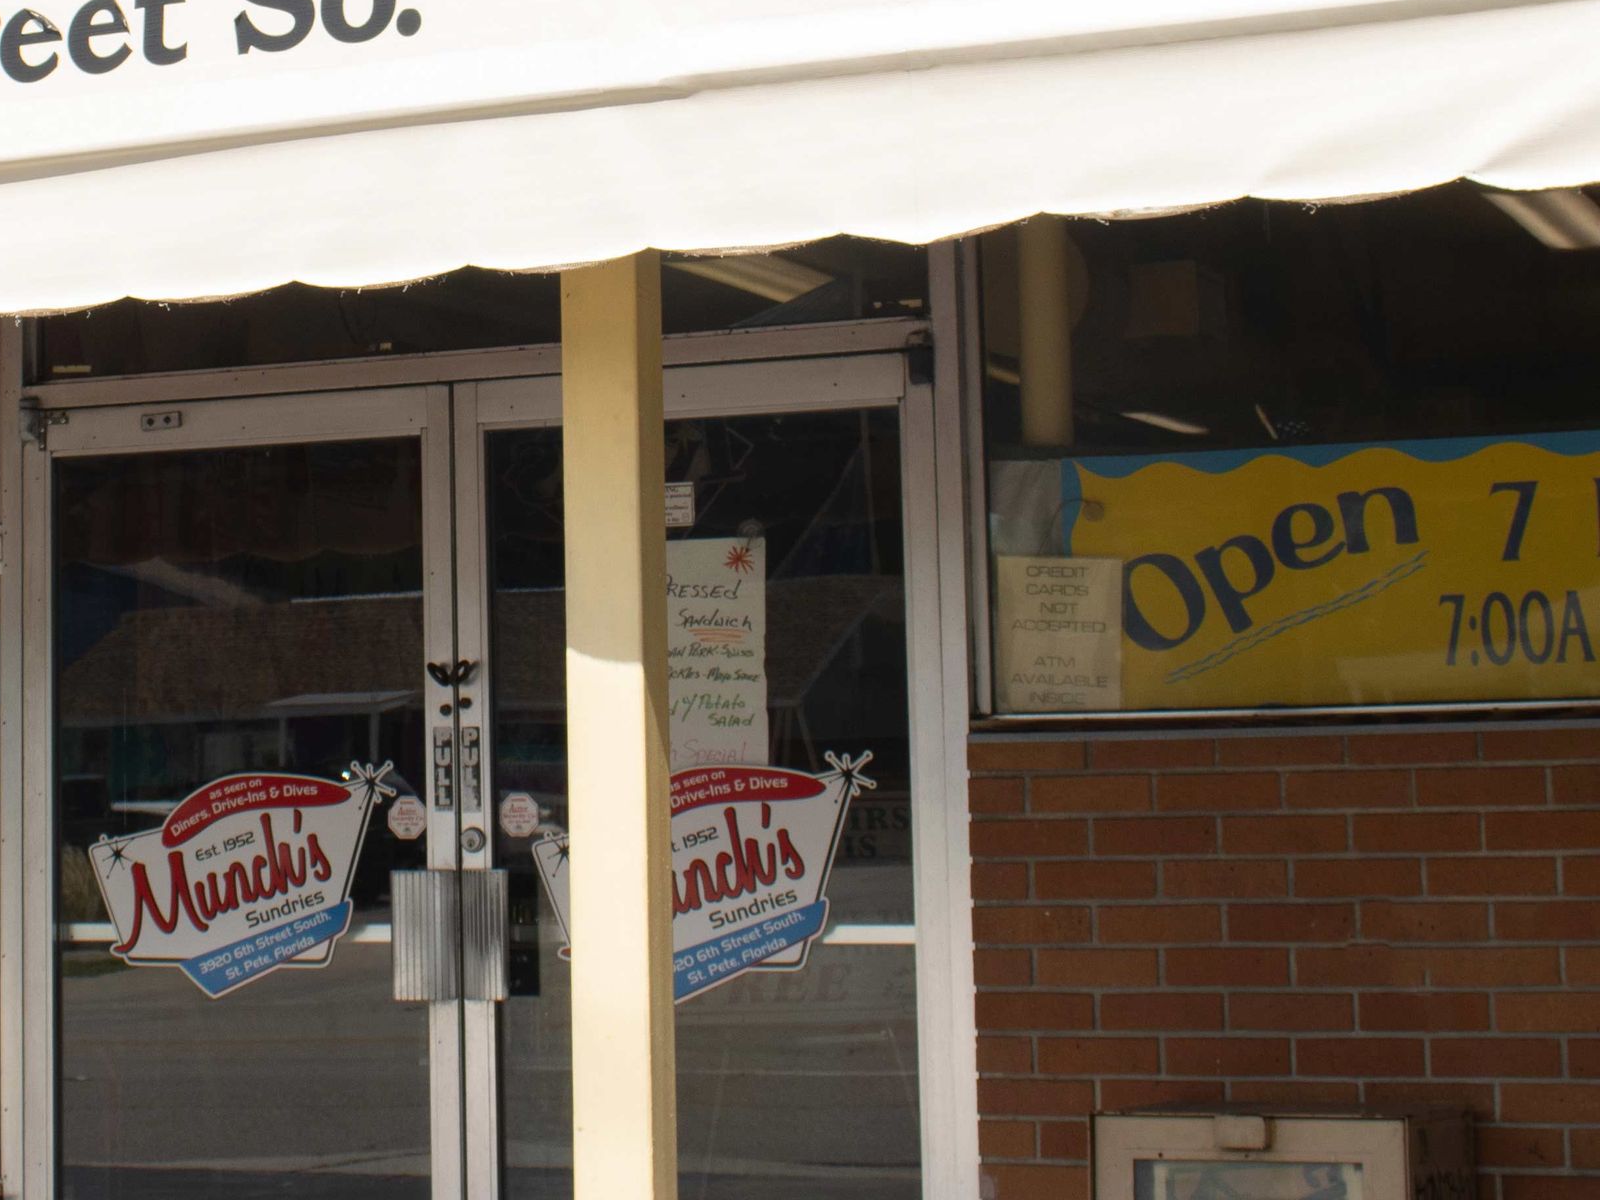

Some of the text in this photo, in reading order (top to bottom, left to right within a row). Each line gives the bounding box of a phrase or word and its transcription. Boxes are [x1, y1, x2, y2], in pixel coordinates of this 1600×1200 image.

[1025, 565, 1090, 578] CREDIT
[1121, 485, 1419, 651] Open
[1489, 480, 1540, 562] 7
[1025, 583, 1089, 597] CARDS
[1039, 601, 1079, 615] NOT
[1010, 618, 1107, 634] ACCEPTED
[1033, 656, 1076, 668] ATM
[1010, 672, 1109, 688] AVAILABLE
[1028, 690, 1088, 705] INSIDE
[433, 727, 453, 807] PULL
[684, 775, 709, 789] seen
[711, 769, 726, 781] on
[209, 779, 263, 800] as seen on
[211, 790, 267, 815] Drive-Ins
[269, 786, 281, 799] &
[282, 783, 319, 798] Dives
[670, 776, 789, 809] Drive-Ins & Dives
[195, 831, 256, 862] Est. 1952
[683, 826, 720, 849] 1952
[114, 808, 332, 954] Munch's
[245, 890, 326, 929] Sundries
[708, 889, 799, 930] Sundries
[198, 954, 232, 976] 3920
[233, 942, 255, 960] 6th
[255, 927, 293, 951] Street
[224, 965, 242, 981] St.
[273, 935, 316, 962] Florida
[687, 969, 706, 986] St.
[741, 937, 788, 964] Florida
[696, 946, 721, 965] 6th
[721, 929, 763, 953] Street
